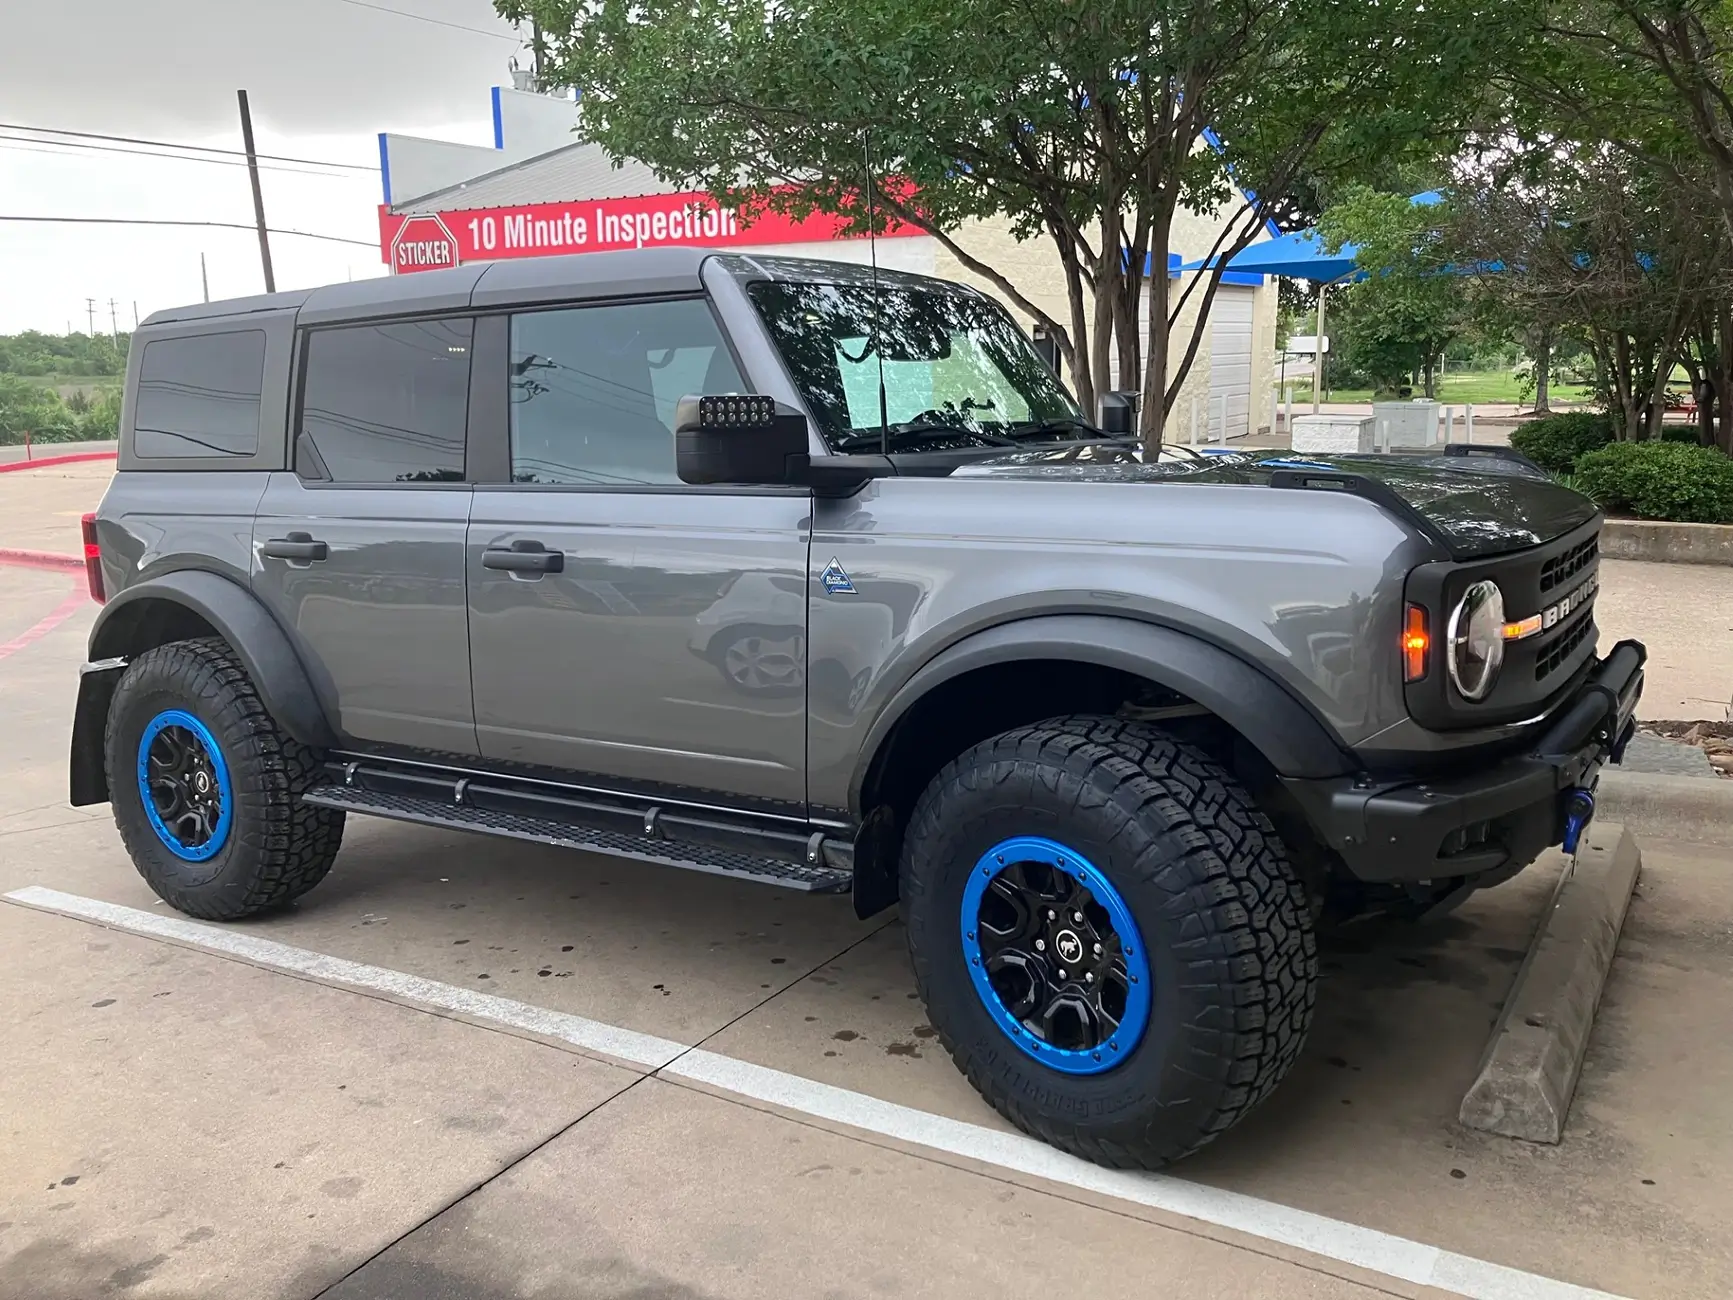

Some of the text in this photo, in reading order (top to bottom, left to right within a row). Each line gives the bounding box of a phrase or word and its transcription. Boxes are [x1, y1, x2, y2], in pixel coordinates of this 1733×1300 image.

[468, 202, 736, 250] 10 Minute Inspection
[398, 240, 450, 265] STICKER
